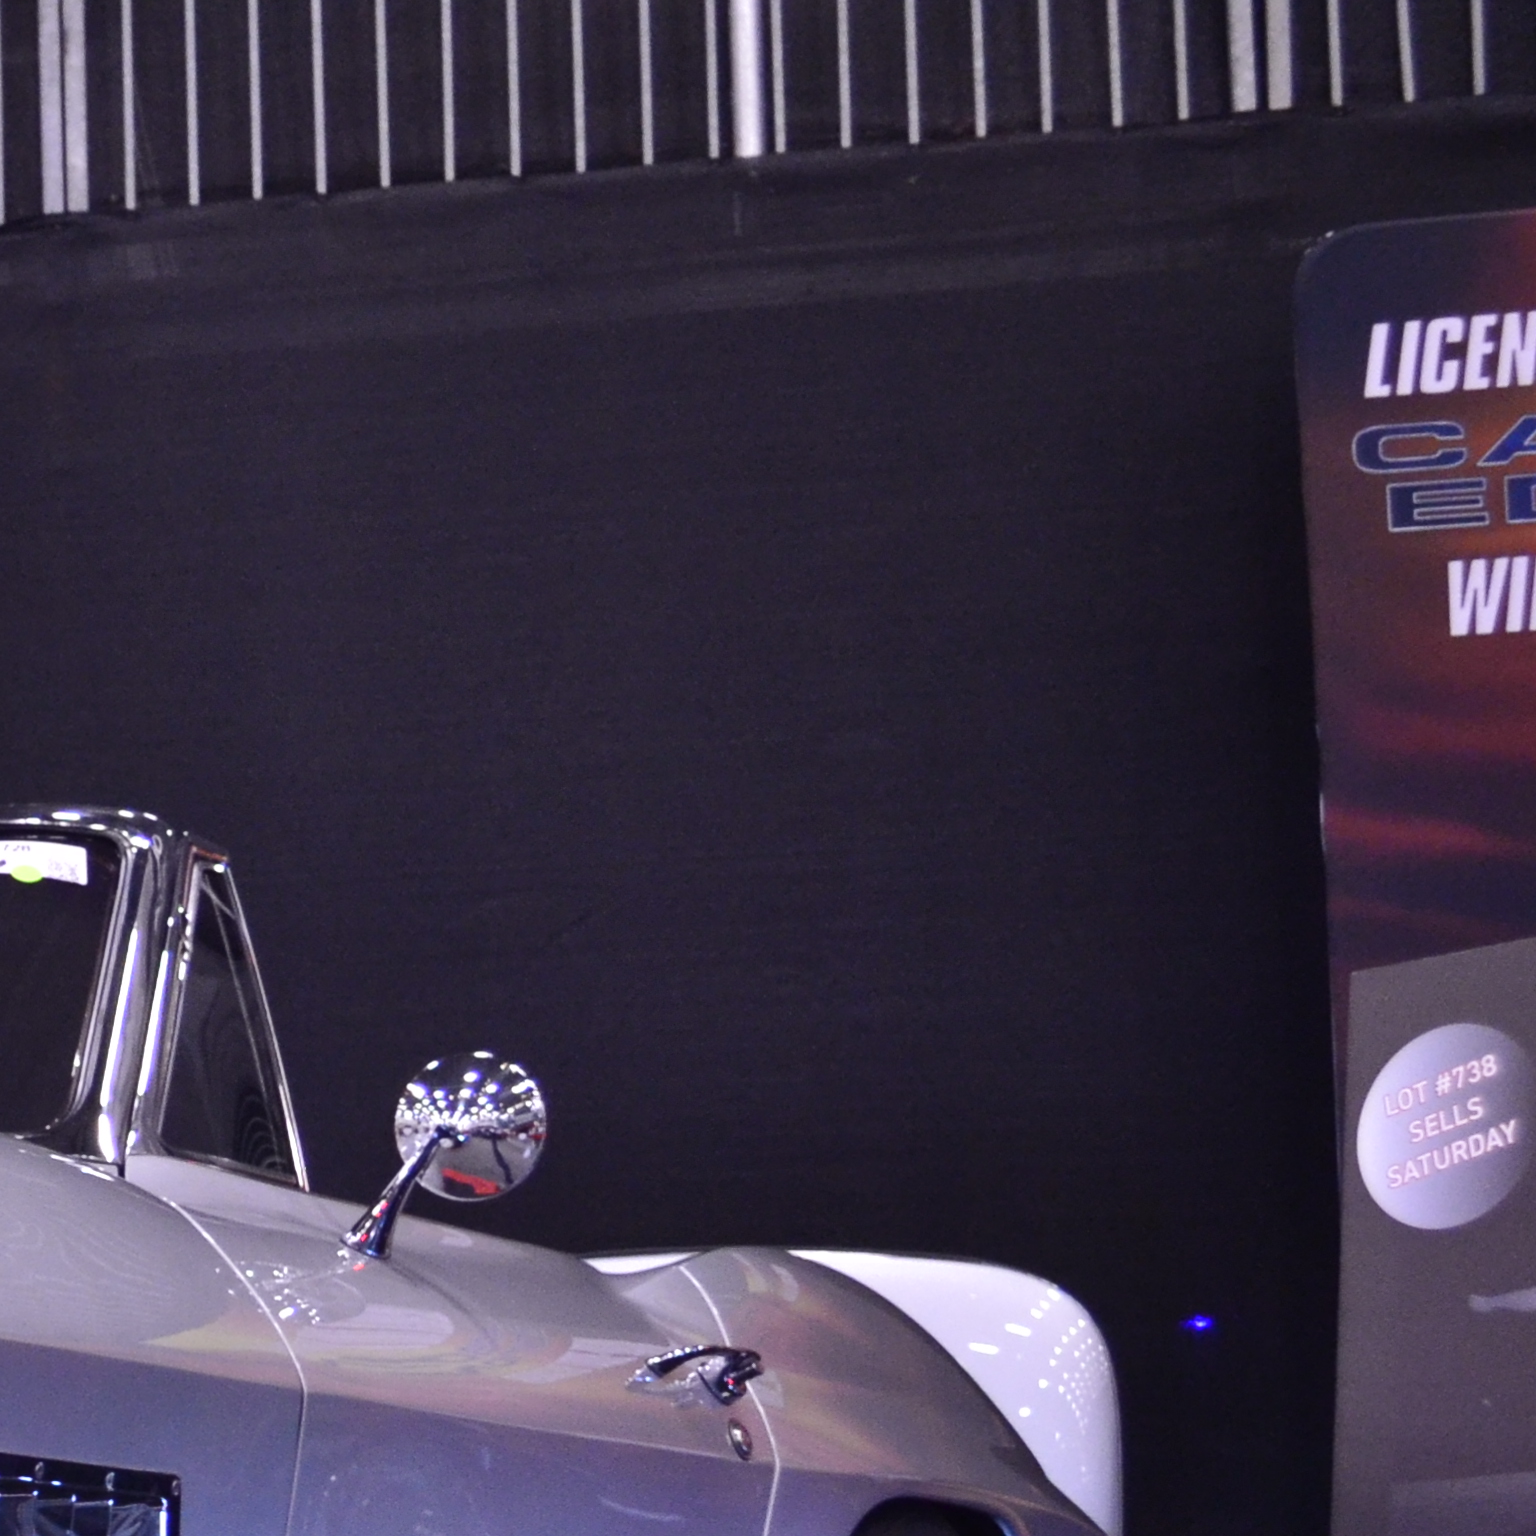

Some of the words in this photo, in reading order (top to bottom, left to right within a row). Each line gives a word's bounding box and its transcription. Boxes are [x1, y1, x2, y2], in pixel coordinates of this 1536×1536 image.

[1364, 310, 1536, 399] LICEN
[1447, 555, 1536, 637] WI
[1384, 1080, 1427, 1116] LOT
[1435, 1054, 1498, 1096] #738
[1408, 1097, 1484, 1142] SELLS
[1386, 1119, 1517, 1188] SATURDAY
